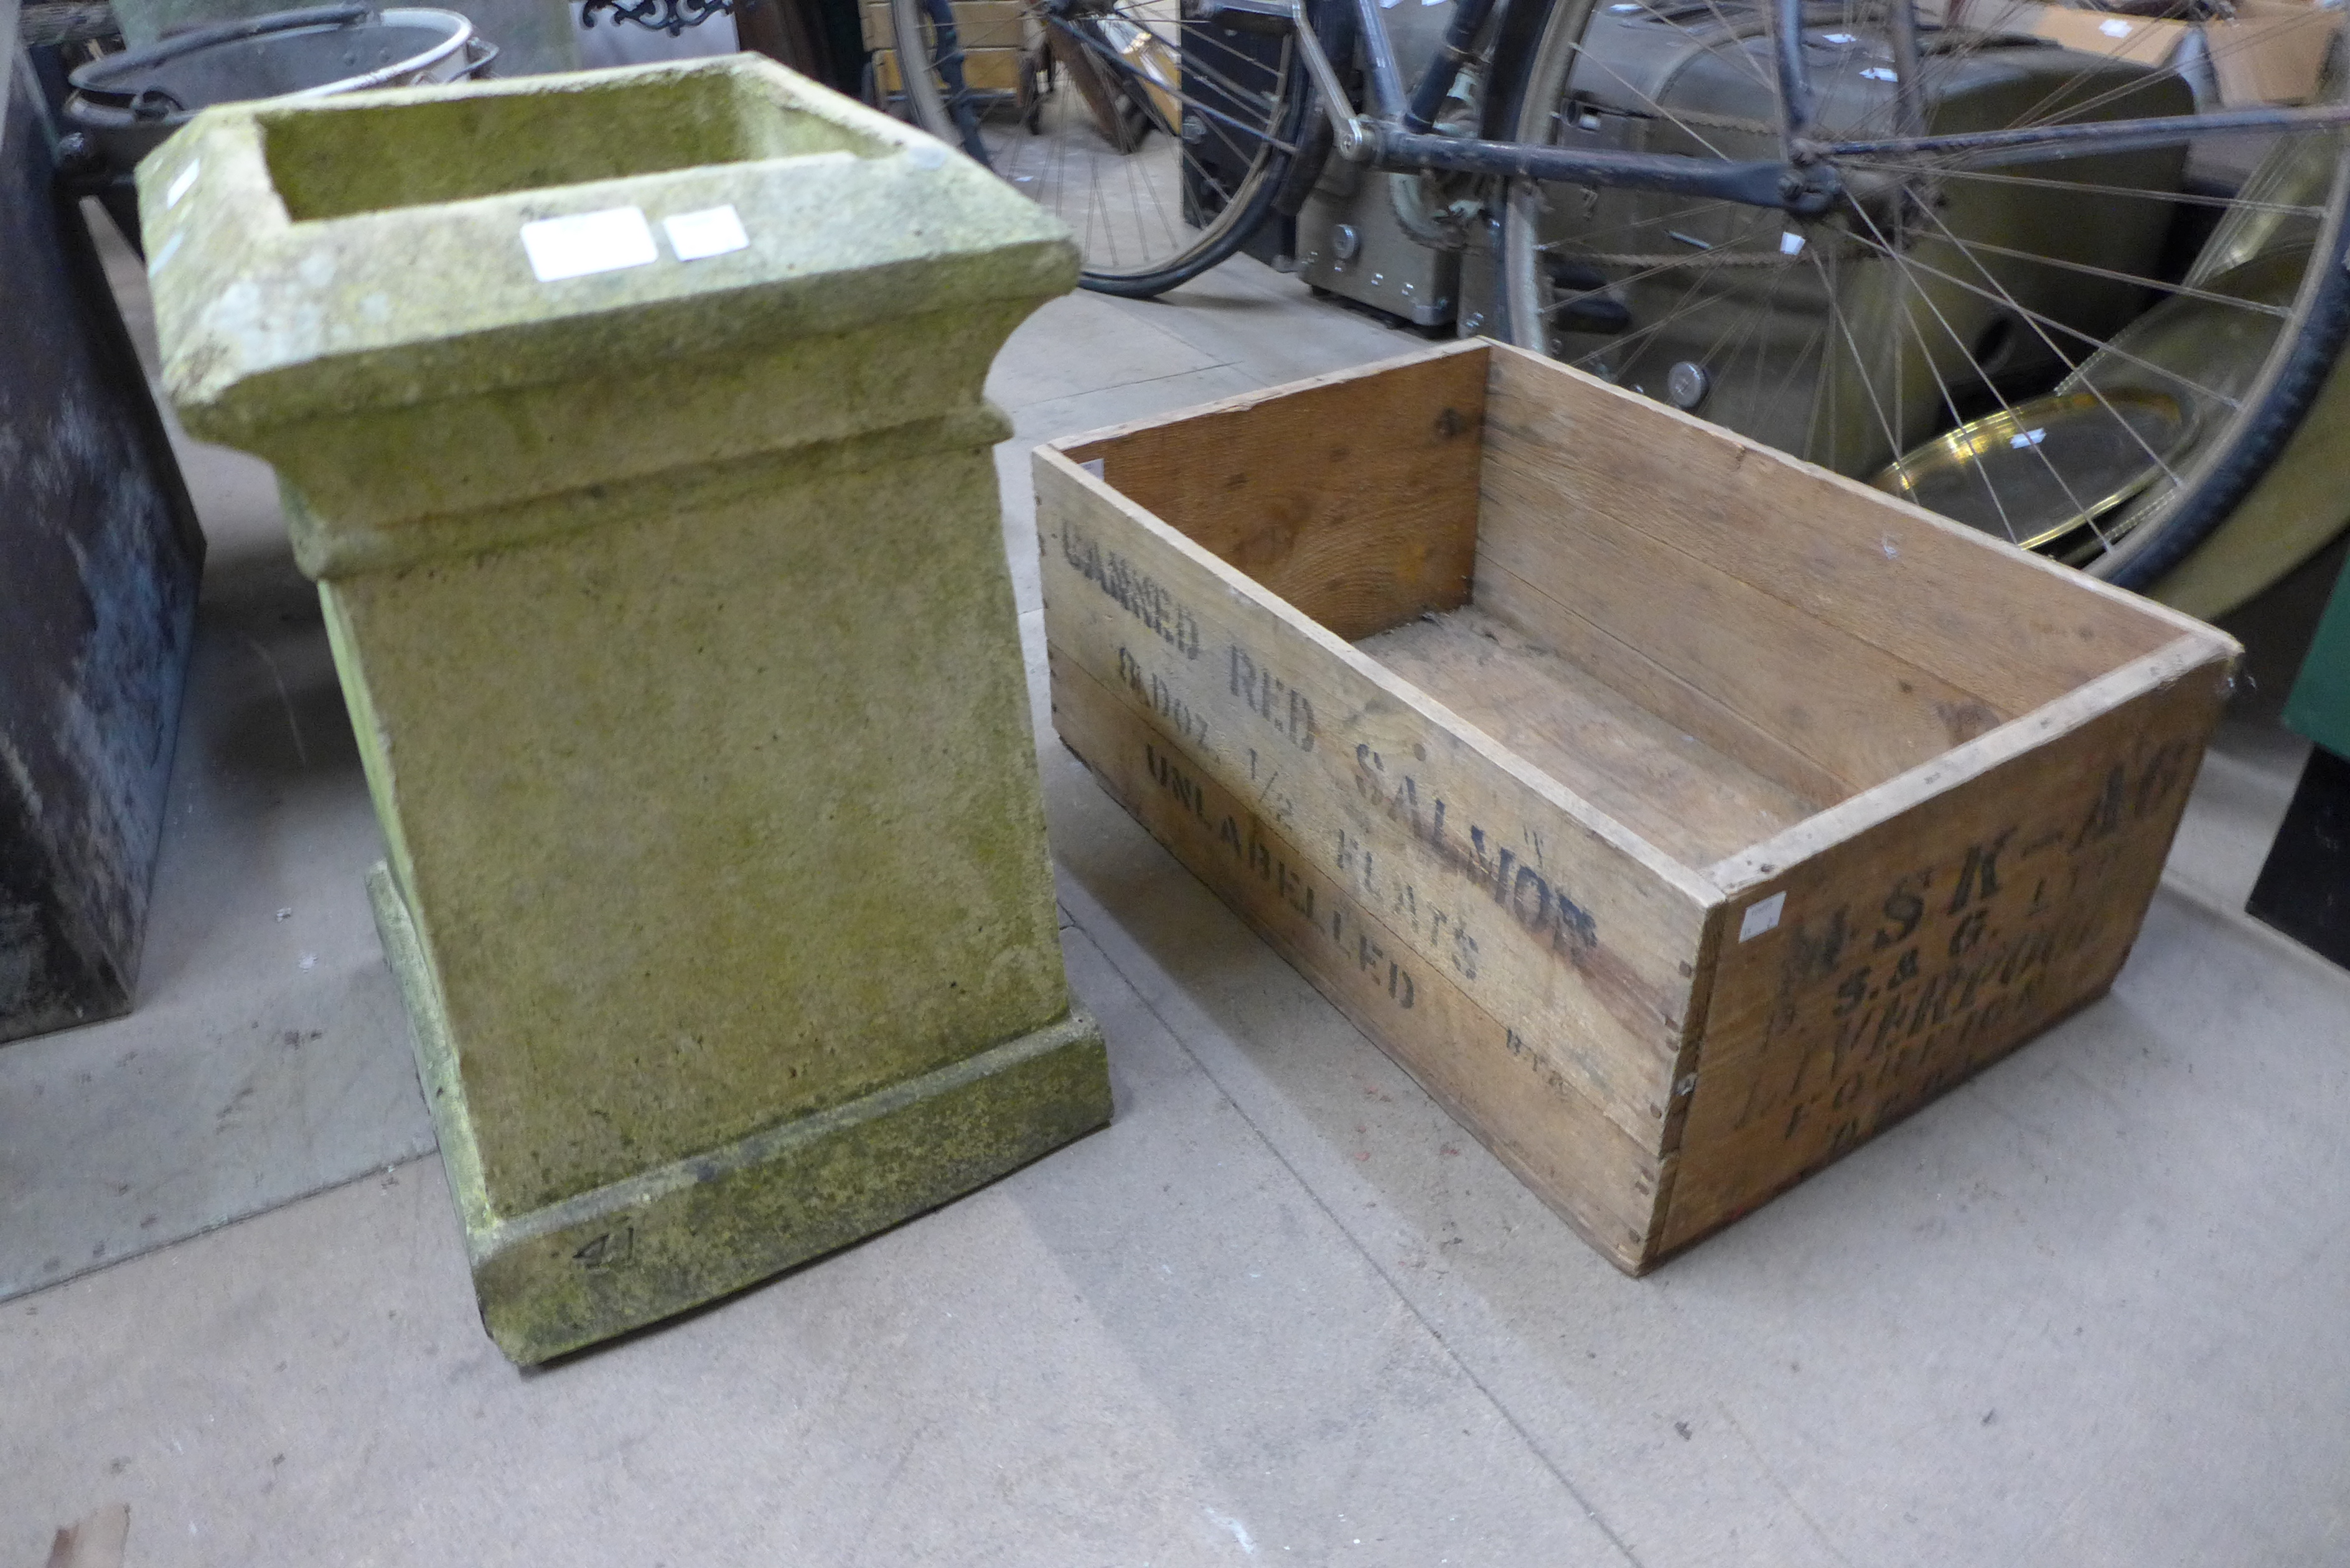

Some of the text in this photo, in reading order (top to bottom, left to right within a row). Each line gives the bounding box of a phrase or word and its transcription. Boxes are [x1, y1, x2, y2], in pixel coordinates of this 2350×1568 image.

[1060, 518, 1599, 976] CANNED RED SALMON
[1146, 742, 1415, 1009] UNLABELLED
[1336, 827, 1479, 981] FLATS
